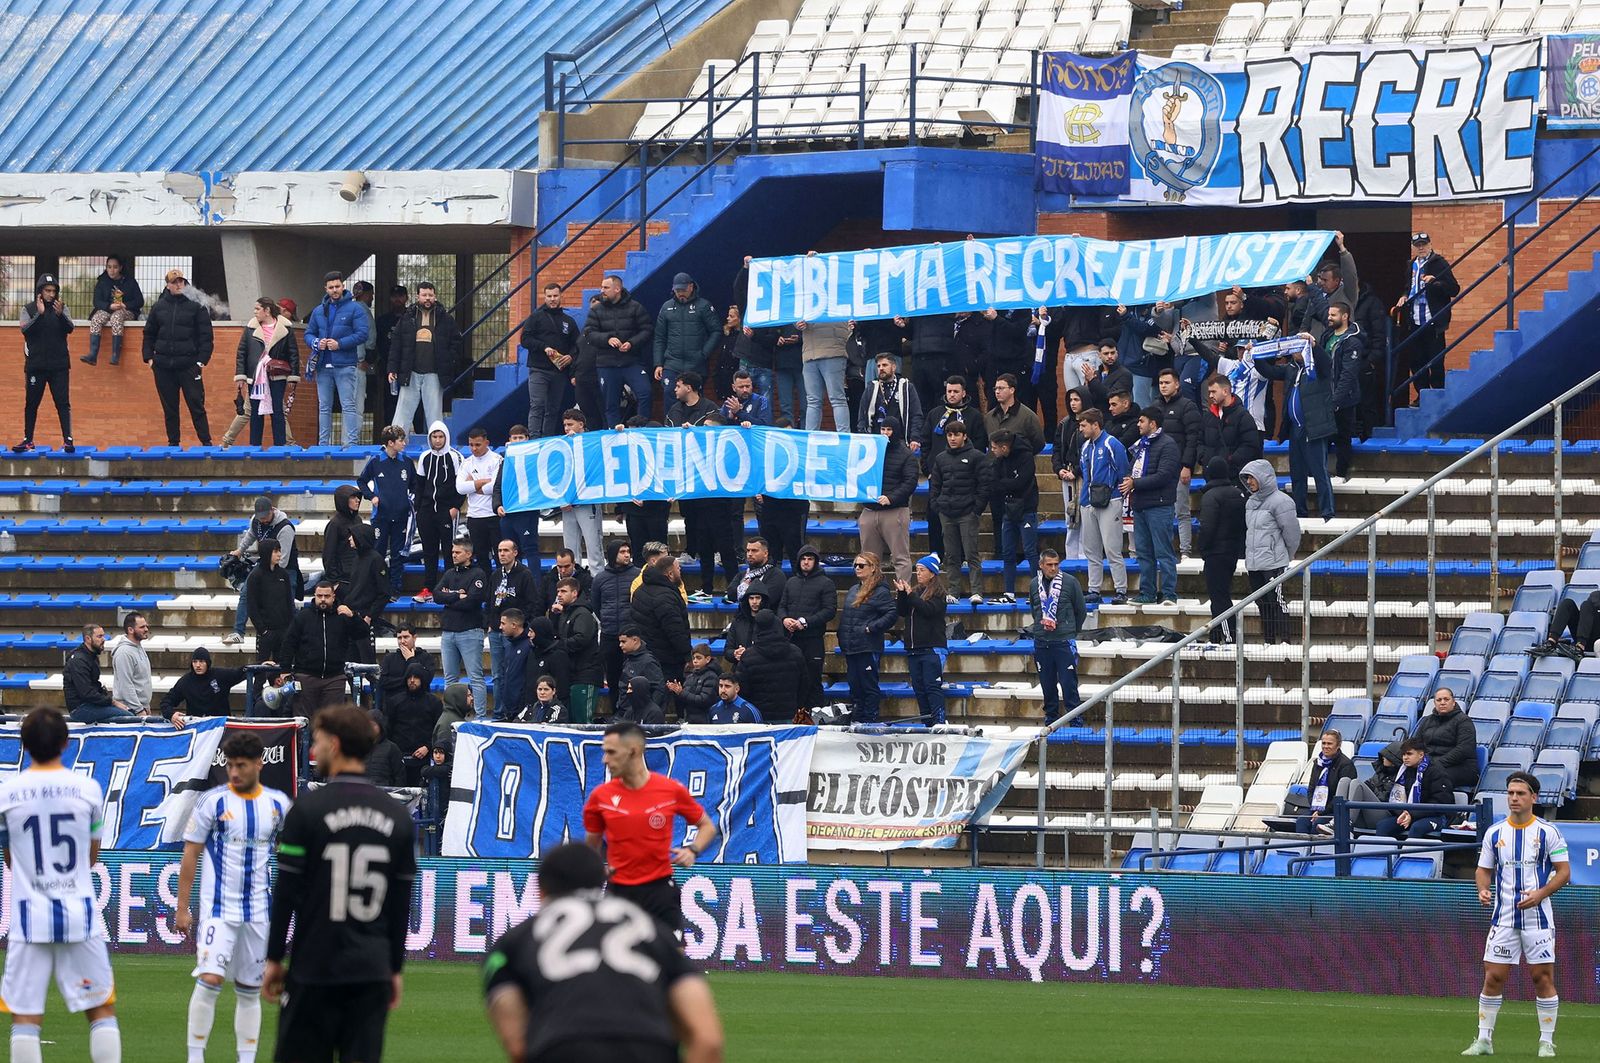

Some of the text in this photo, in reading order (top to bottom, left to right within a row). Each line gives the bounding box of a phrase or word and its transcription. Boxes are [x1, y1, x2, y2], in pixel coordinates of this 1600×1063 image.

[1572, 43, 1600, 57] PEL
[1234, 38, 1541, 203] RECRE
[745, 231, 1323, 324] EMBLEMA RECREATIVISTA
[504, 429, 751, 504] TOLEDANO
[856, 741, 947, 766] SECTOR
[465, 732, 784, 864] ONBA
[810, 824, 855, 838] DECANO
[859, 827, 877, 838] DEL
[23, 813, 77, 876] 15
[321, 842, 392, 922] 15
[205, 926, 216, 945] 8
[533, 895, 661, 982] 22
[1493, 945, 1511, 955] Olin
